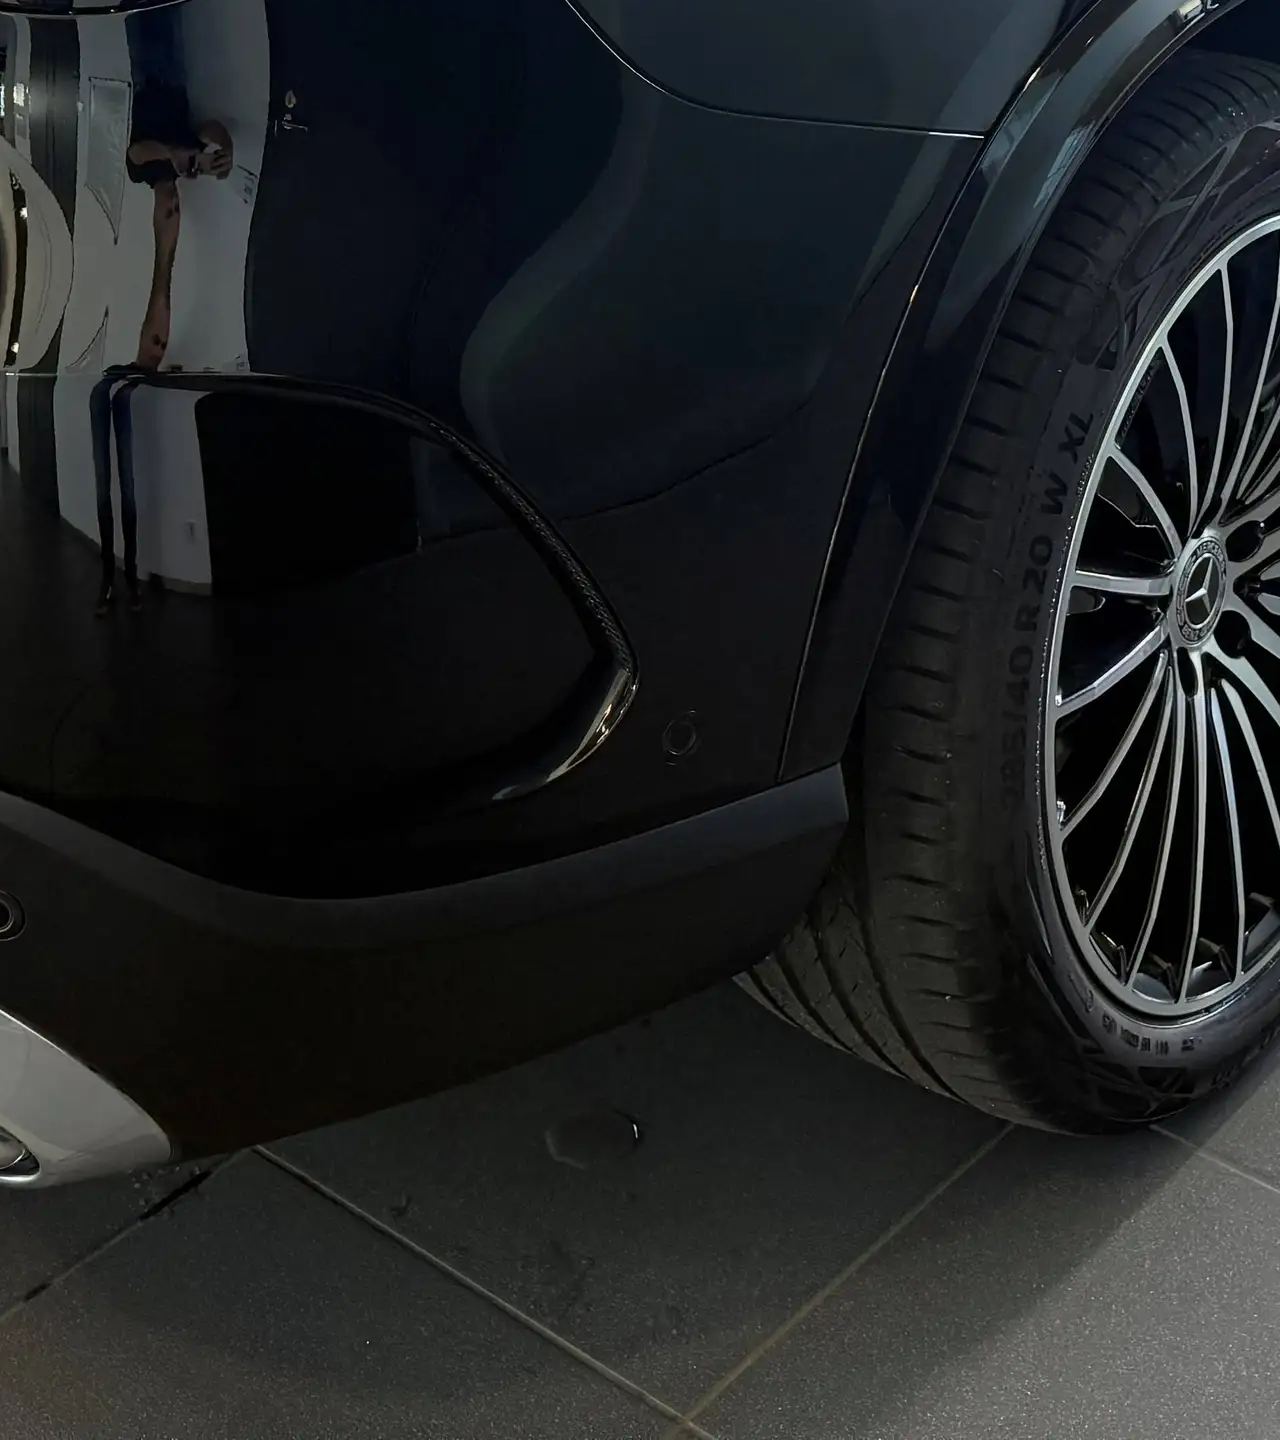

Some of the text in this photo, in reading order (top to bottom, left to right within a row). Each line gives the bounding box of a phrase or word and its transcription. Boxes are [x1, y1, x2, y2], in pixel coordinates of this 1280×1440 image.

[1057, 411, 1094, 464] XL
[1039, 468, 1068, 516] W
[1022, 534, 1053, 594] 20
[1012, 603, 1041, 632] R
